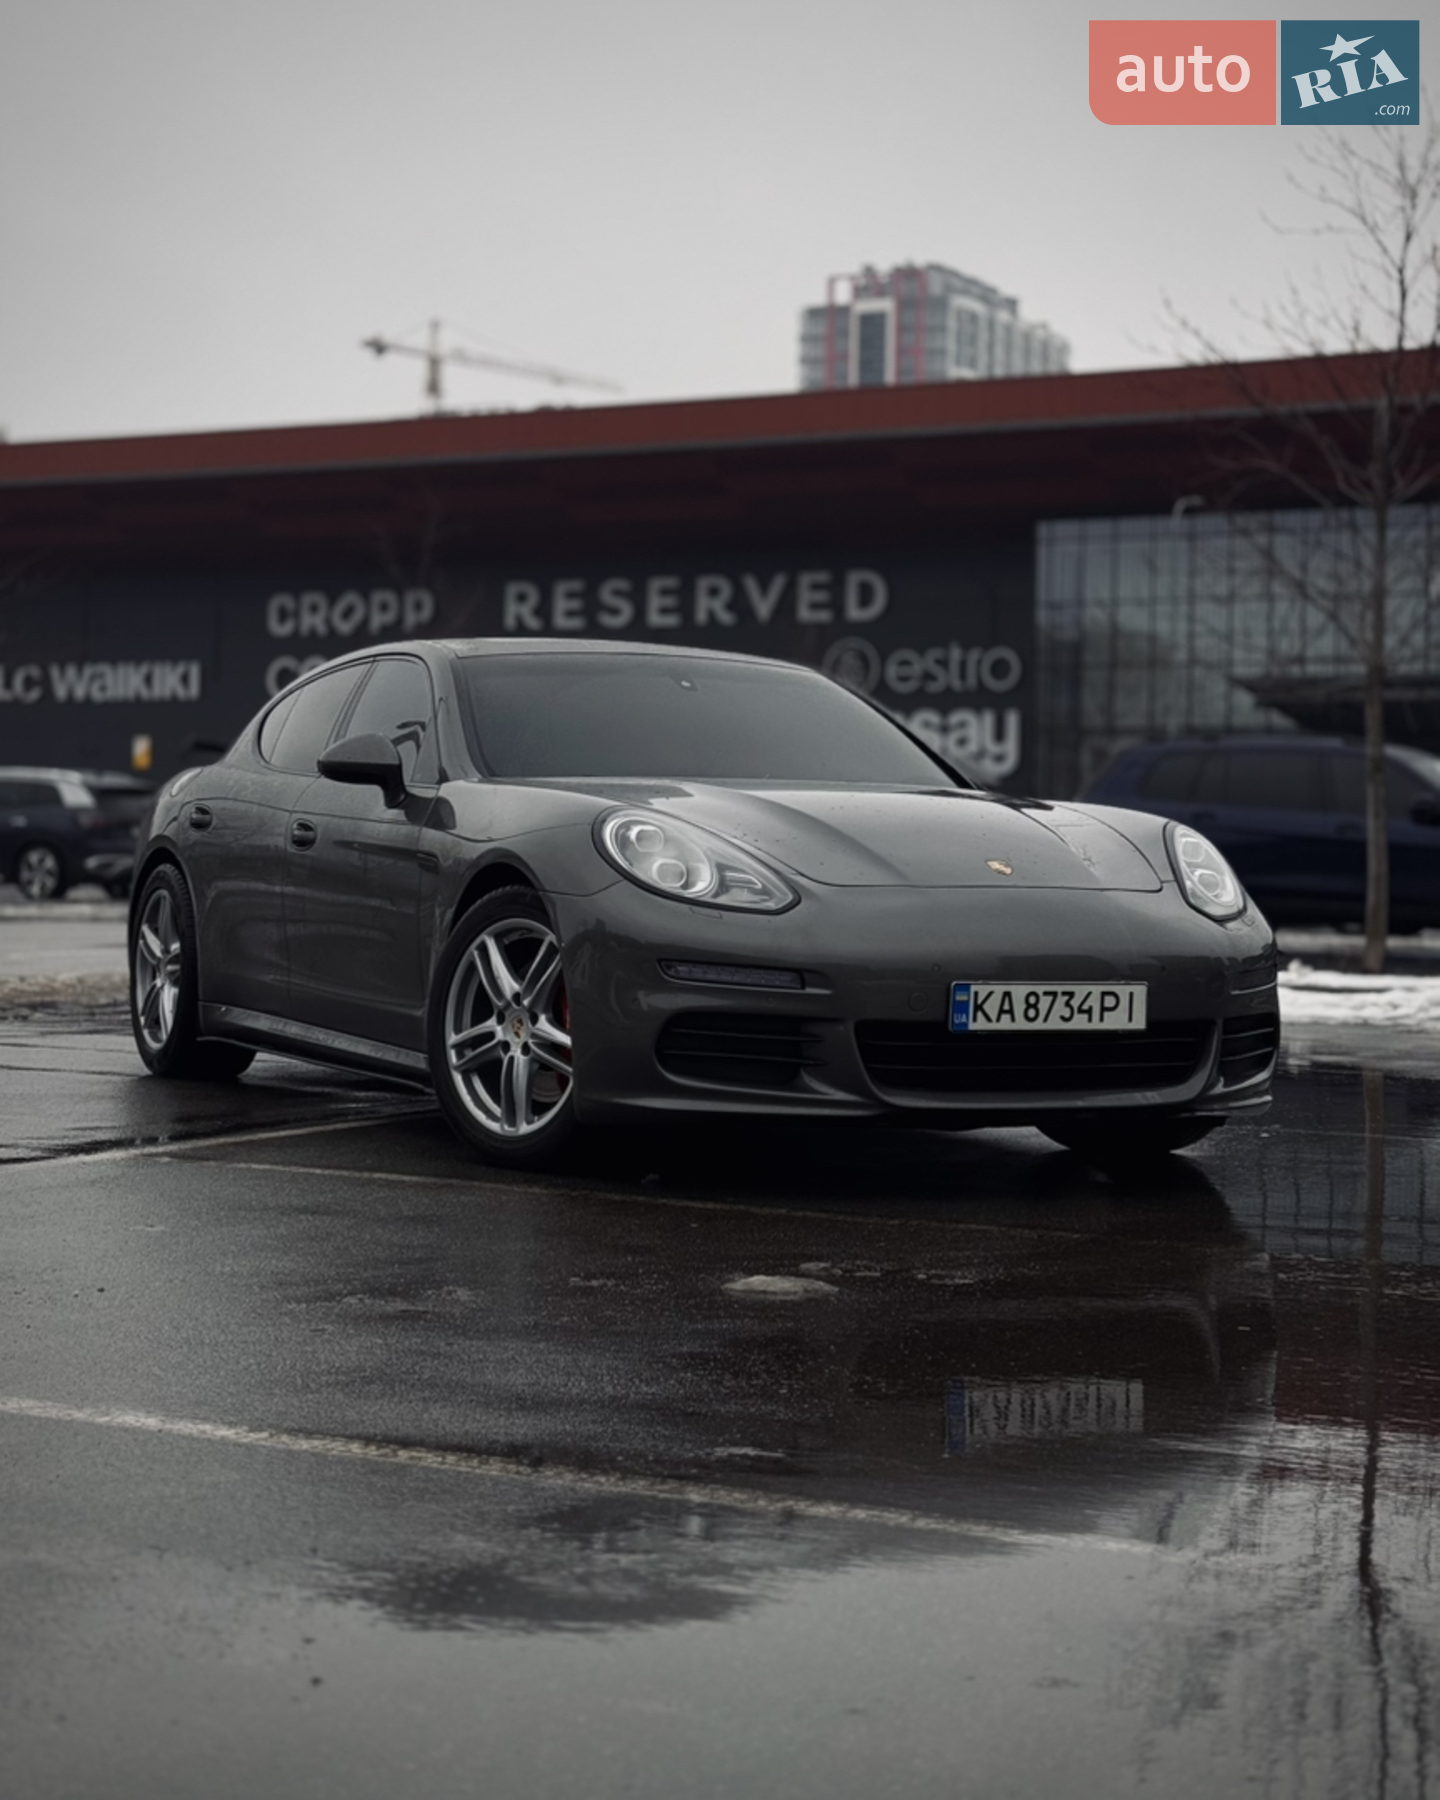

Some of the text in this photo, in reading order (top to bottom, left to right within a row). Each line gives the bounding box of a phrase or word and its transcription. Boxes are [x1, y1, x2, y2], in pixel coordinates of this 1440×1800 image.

[266, 588, 436, 638] CROPP
[502, 568, 889, 631] RESERVED
[884, 640, 1023, 695] estro
